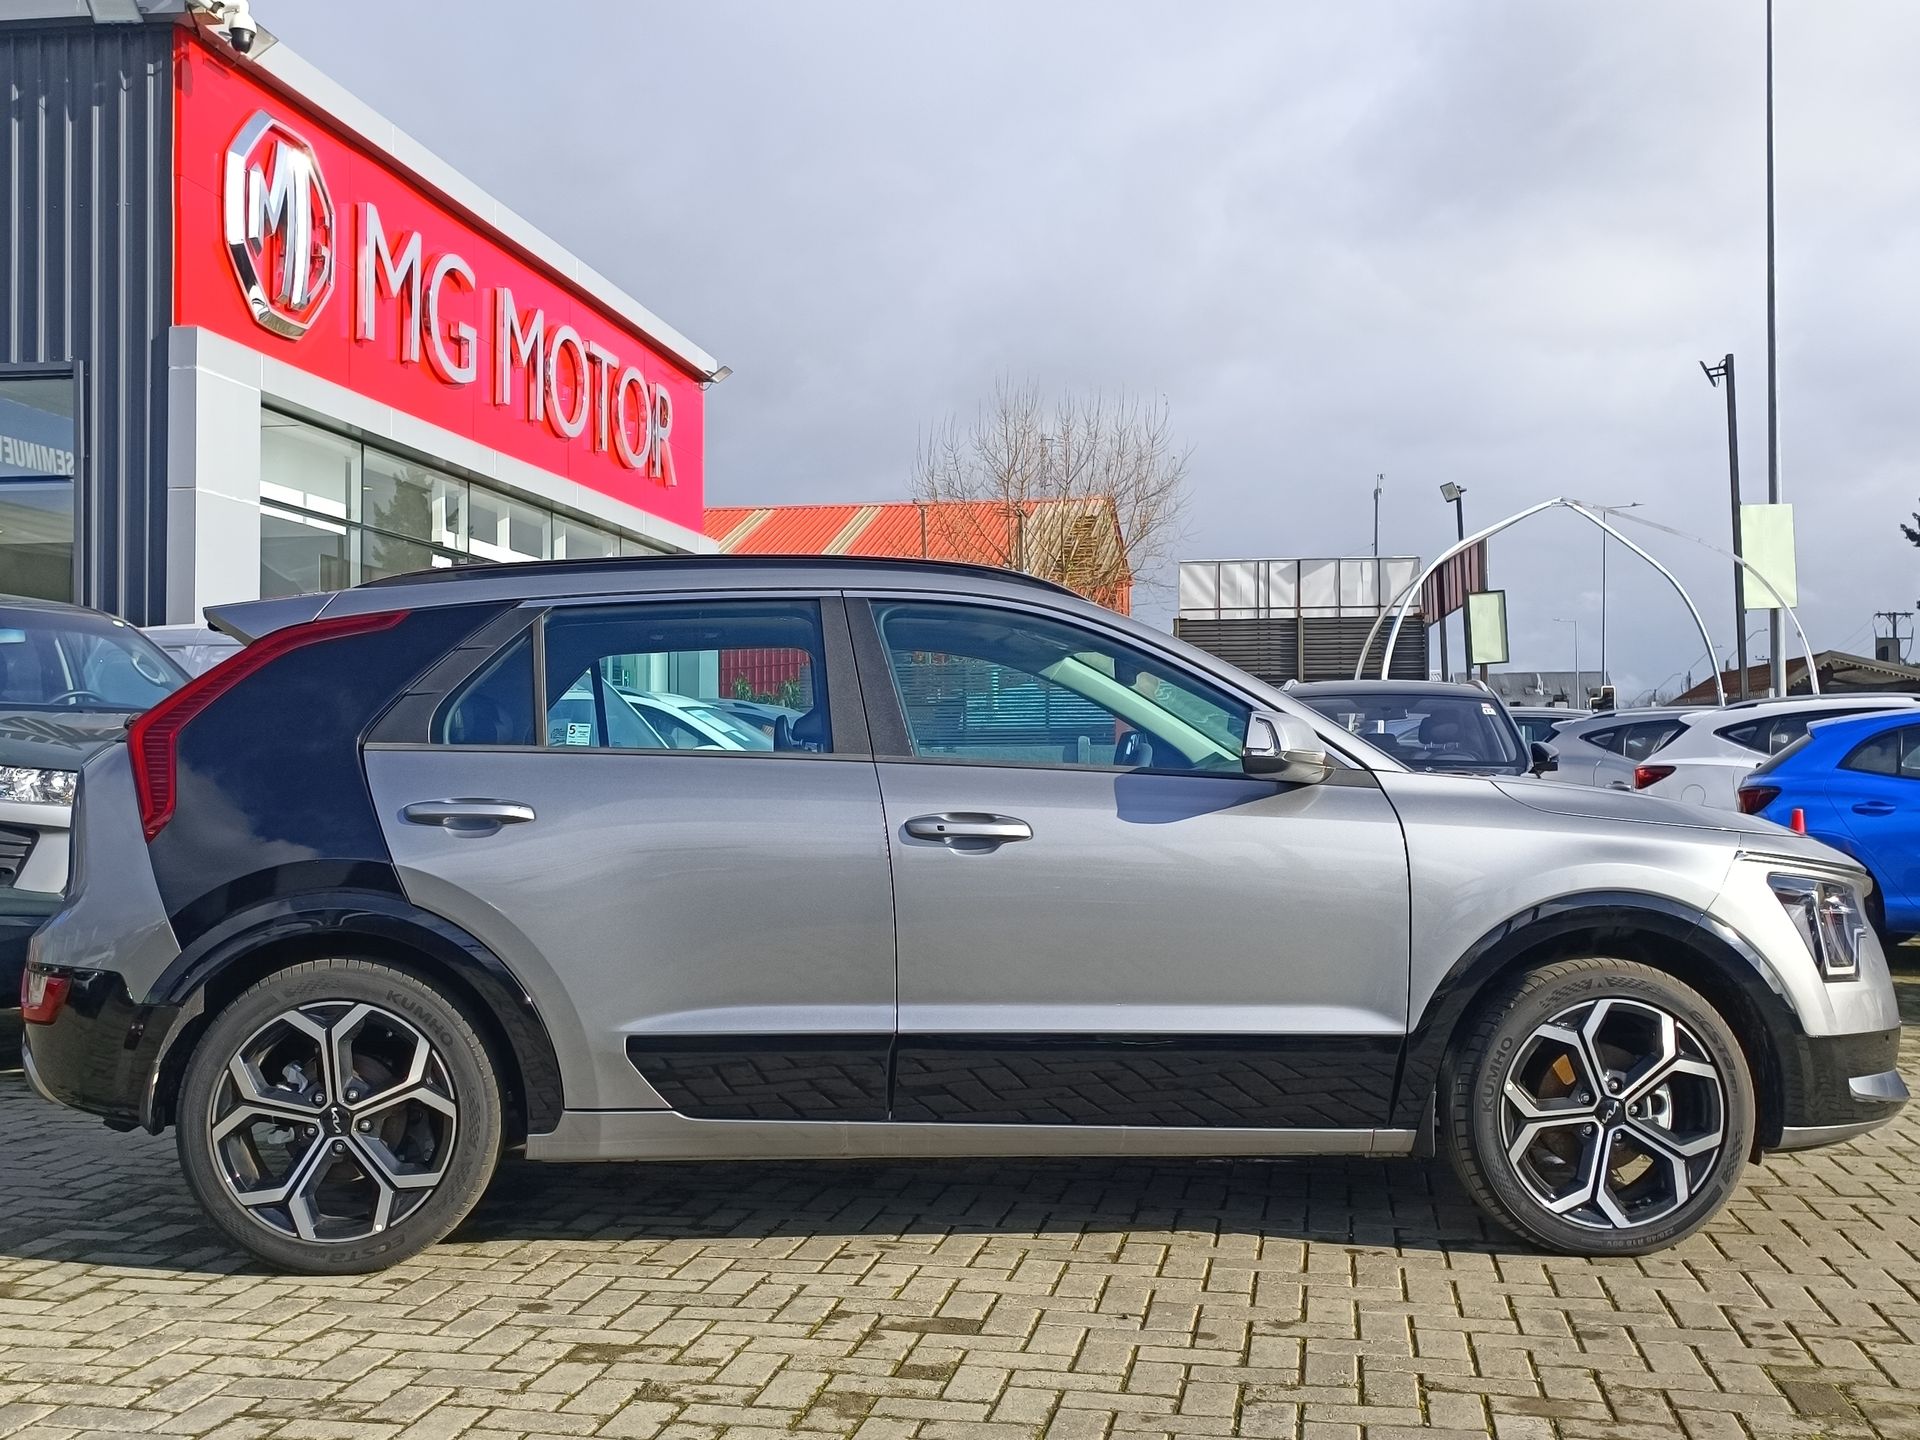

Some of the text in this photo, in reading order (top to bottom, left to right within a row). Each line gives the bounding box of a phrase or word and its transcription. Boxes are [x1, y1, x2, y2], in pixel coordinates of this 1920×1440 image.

[357, 201, 677, 487] MG MOTOR
[386, 989, 454, 1048] KUMHO
[1481, 1036, 1514, 1113] KUMHO
